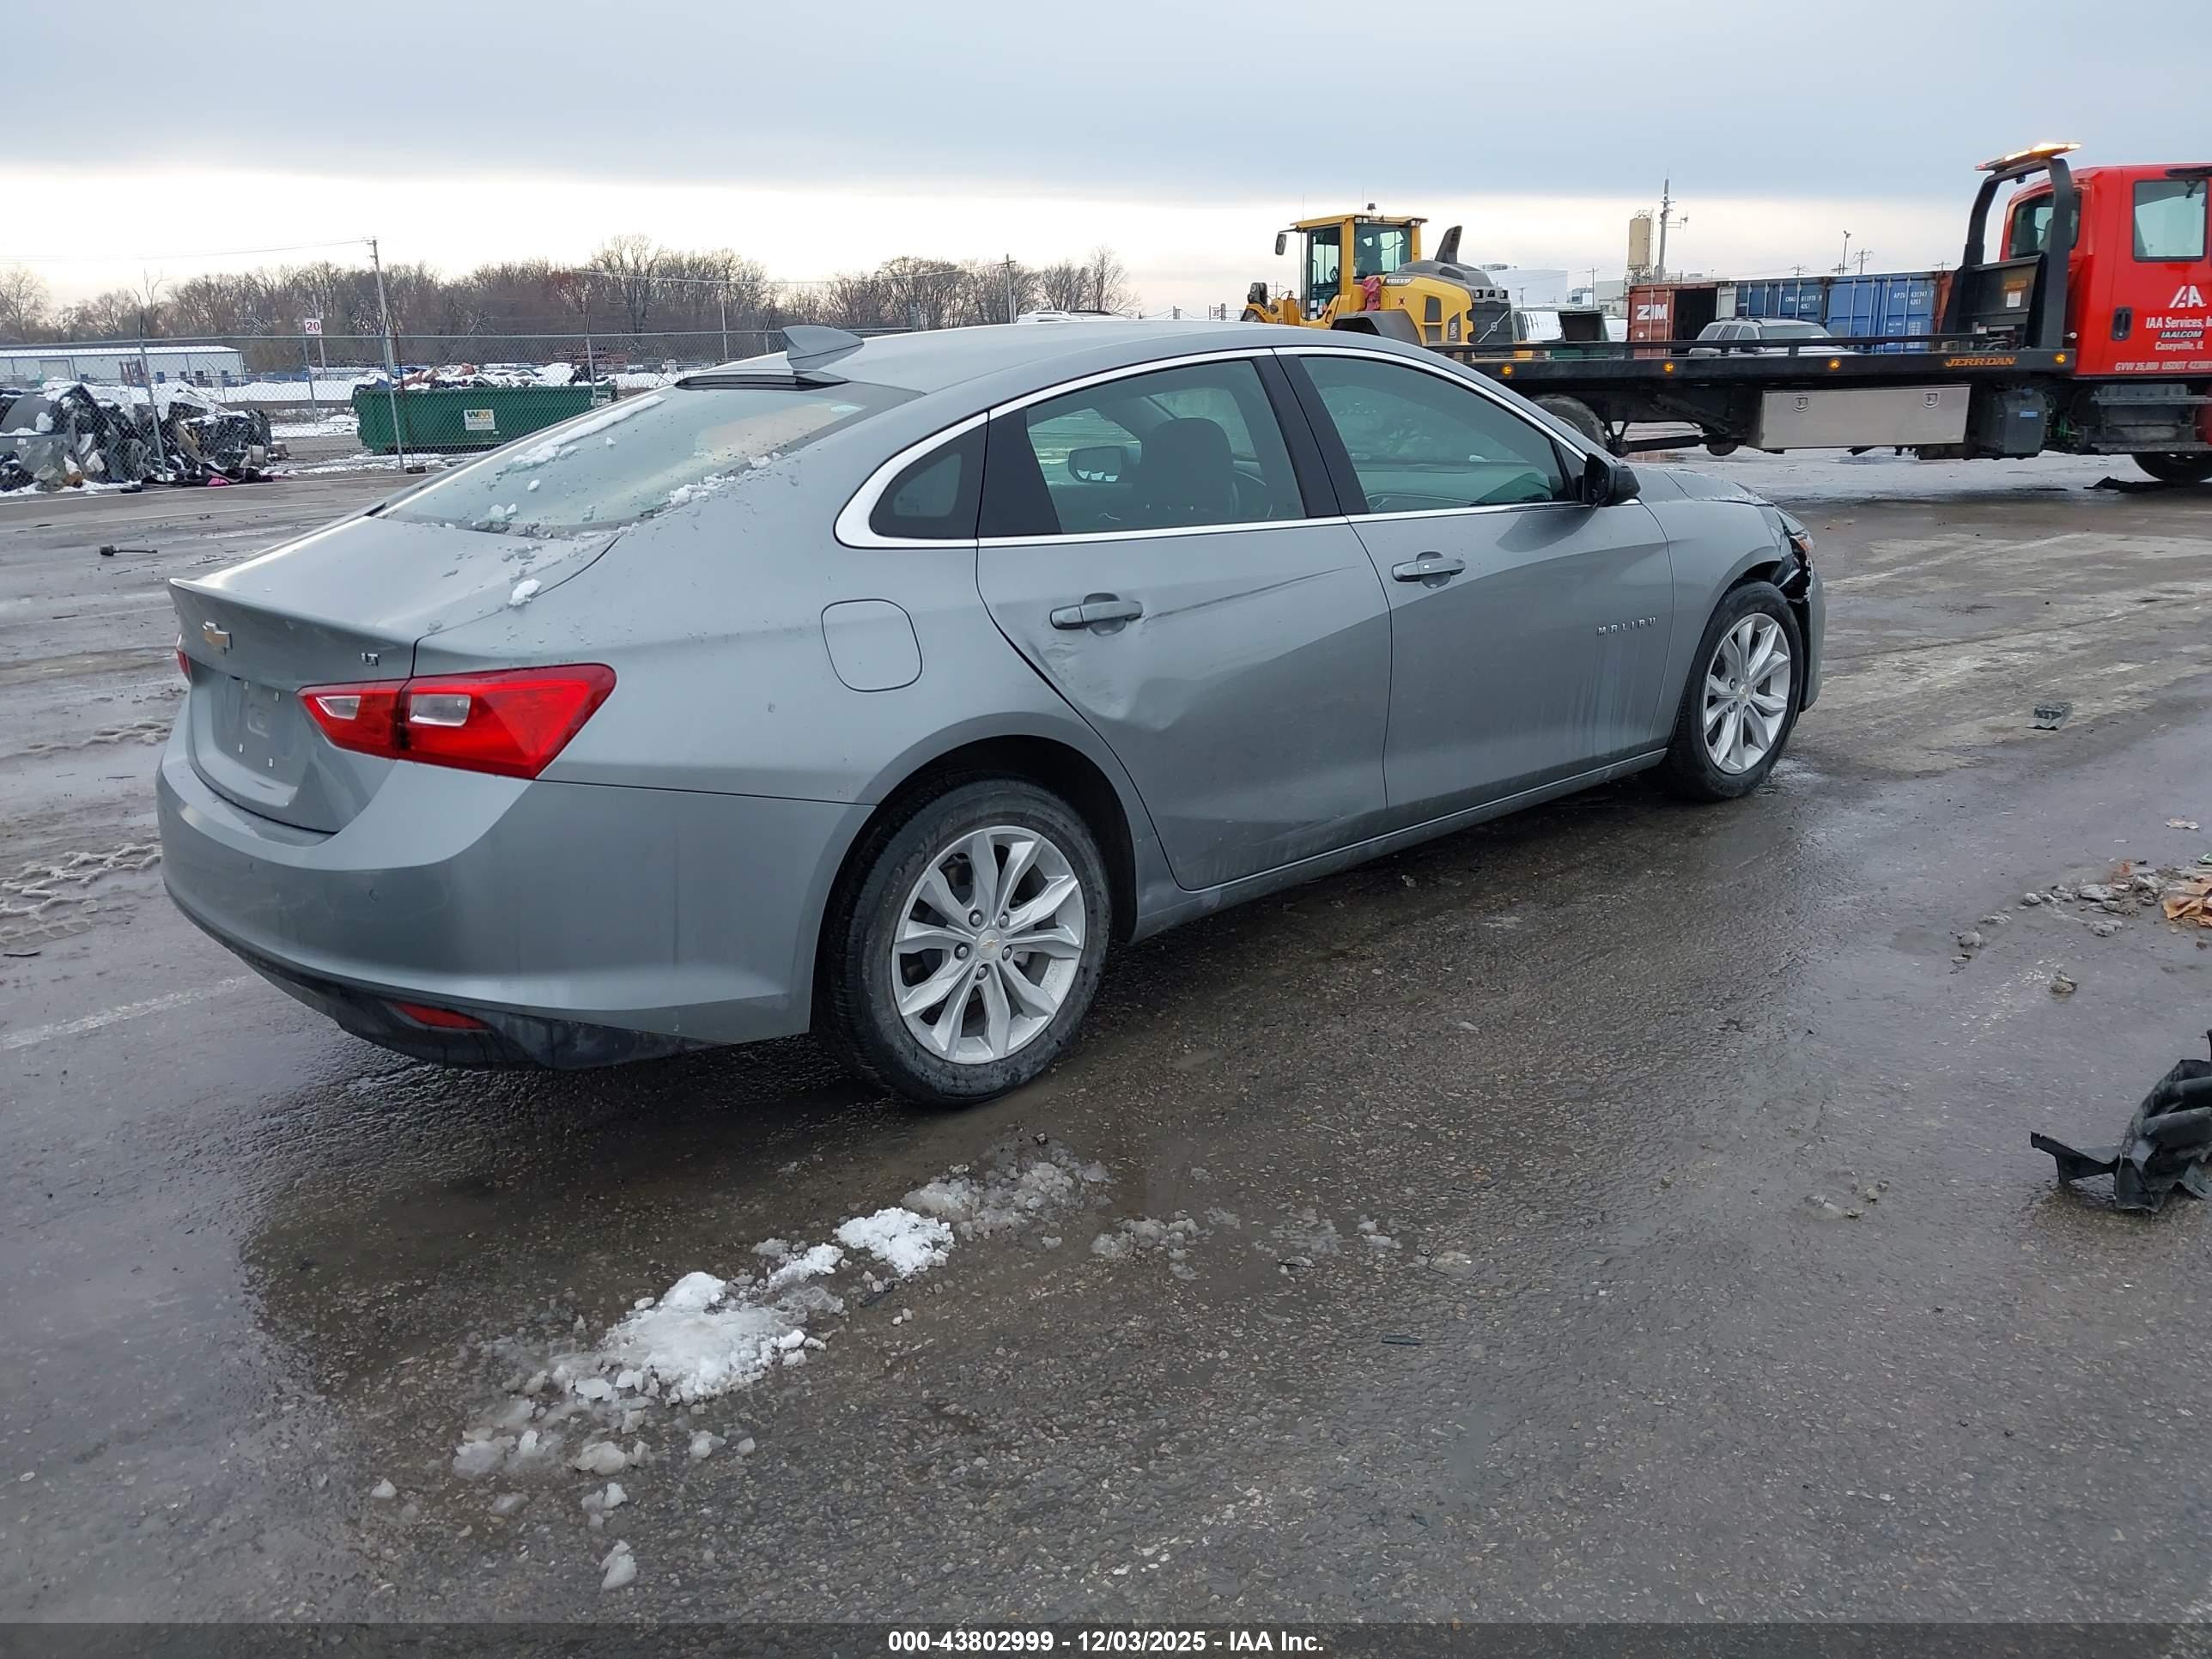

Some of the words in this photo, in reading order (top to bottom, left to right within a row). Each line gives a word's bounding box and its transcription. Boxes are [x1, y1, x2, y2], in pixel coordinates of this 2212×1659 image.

[1637, 304, 1668, 320] ZIM
[307, 321, 320, 331] 20
[2146, 317, 2163, 329] IAA
[362, 652, 379, 666] LT
